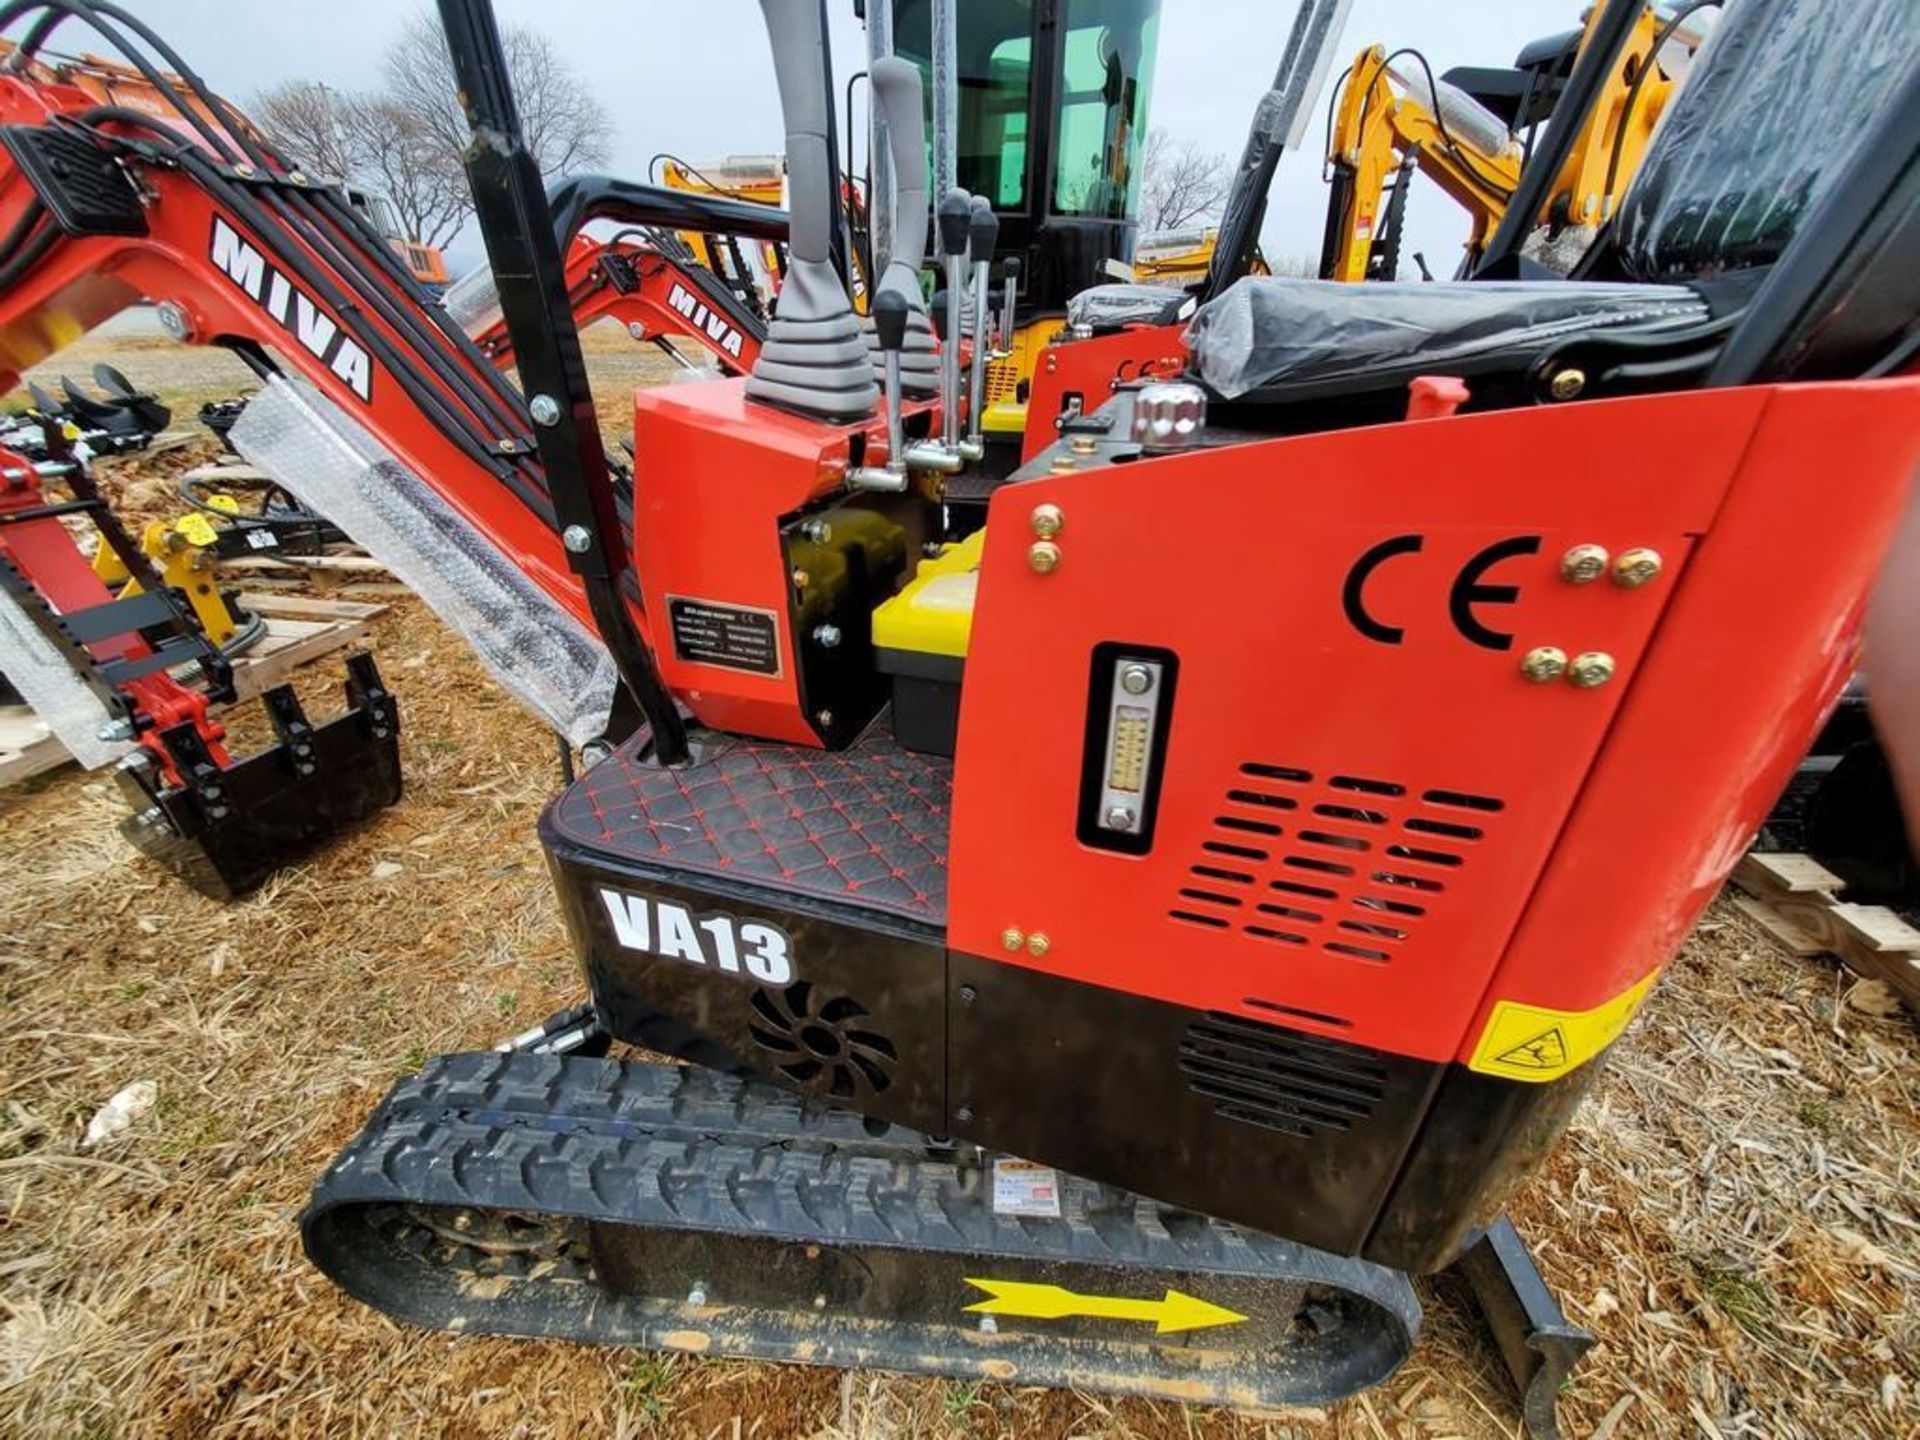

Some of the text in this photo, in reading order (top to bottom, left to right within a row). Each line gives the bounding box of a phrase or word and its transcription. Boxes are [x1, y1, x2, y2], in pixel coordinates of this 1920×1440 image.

[212, 216, 369, 402] MIVA
[668, 283, 744, 358] MIVA
[1343, 535, 1542, 651] CE
[600, 888, 791, 984] VA13
